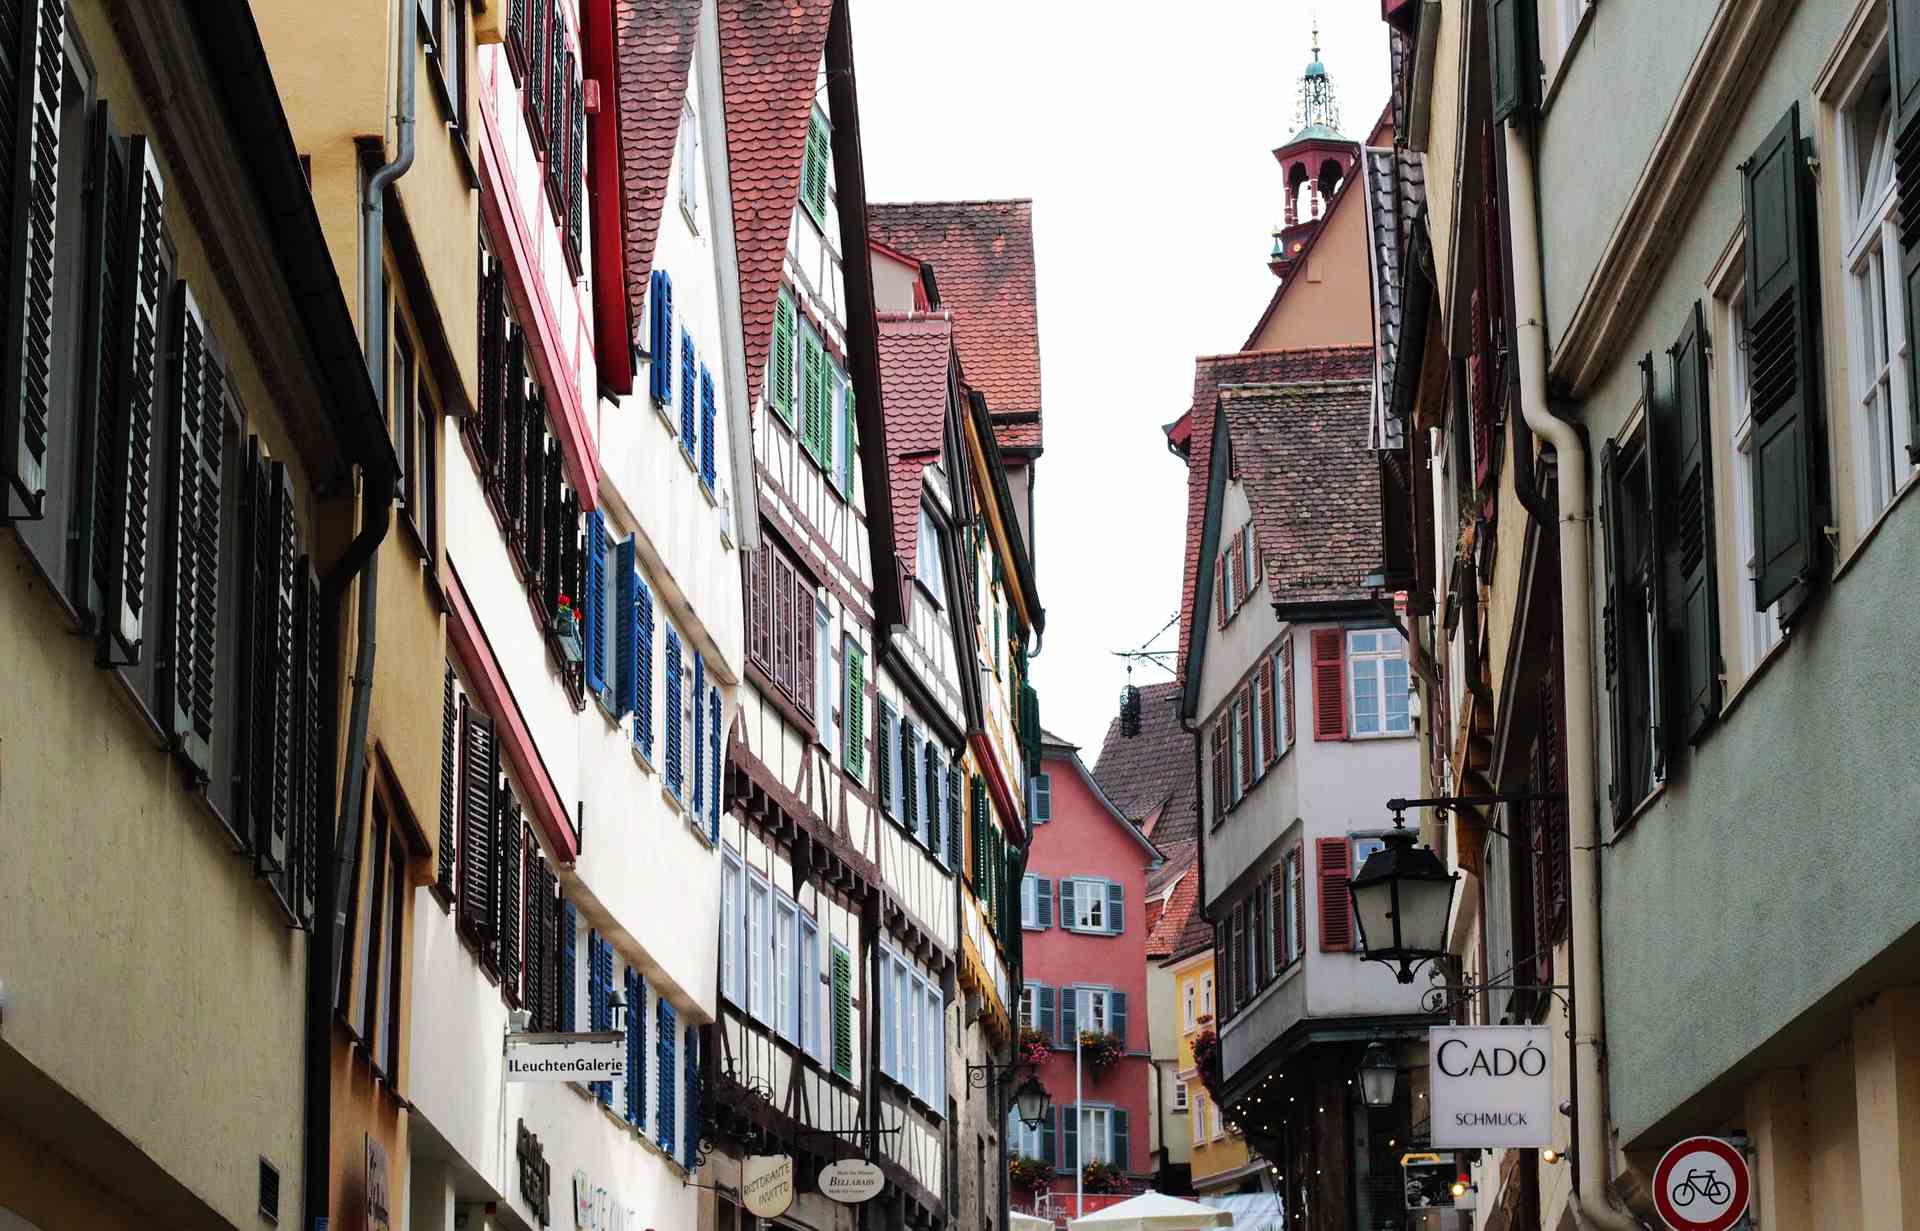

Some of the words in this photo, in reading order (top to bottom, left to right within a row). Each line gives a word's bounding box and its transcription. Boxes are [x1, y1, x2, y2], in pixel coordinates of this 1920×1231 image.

[1437, 1039, 1546, 1077] CADÓ
[1455, 1112, 1528, 1126] SCHMUCK
[743, 1162, 791, 1197] RISTORANTE
